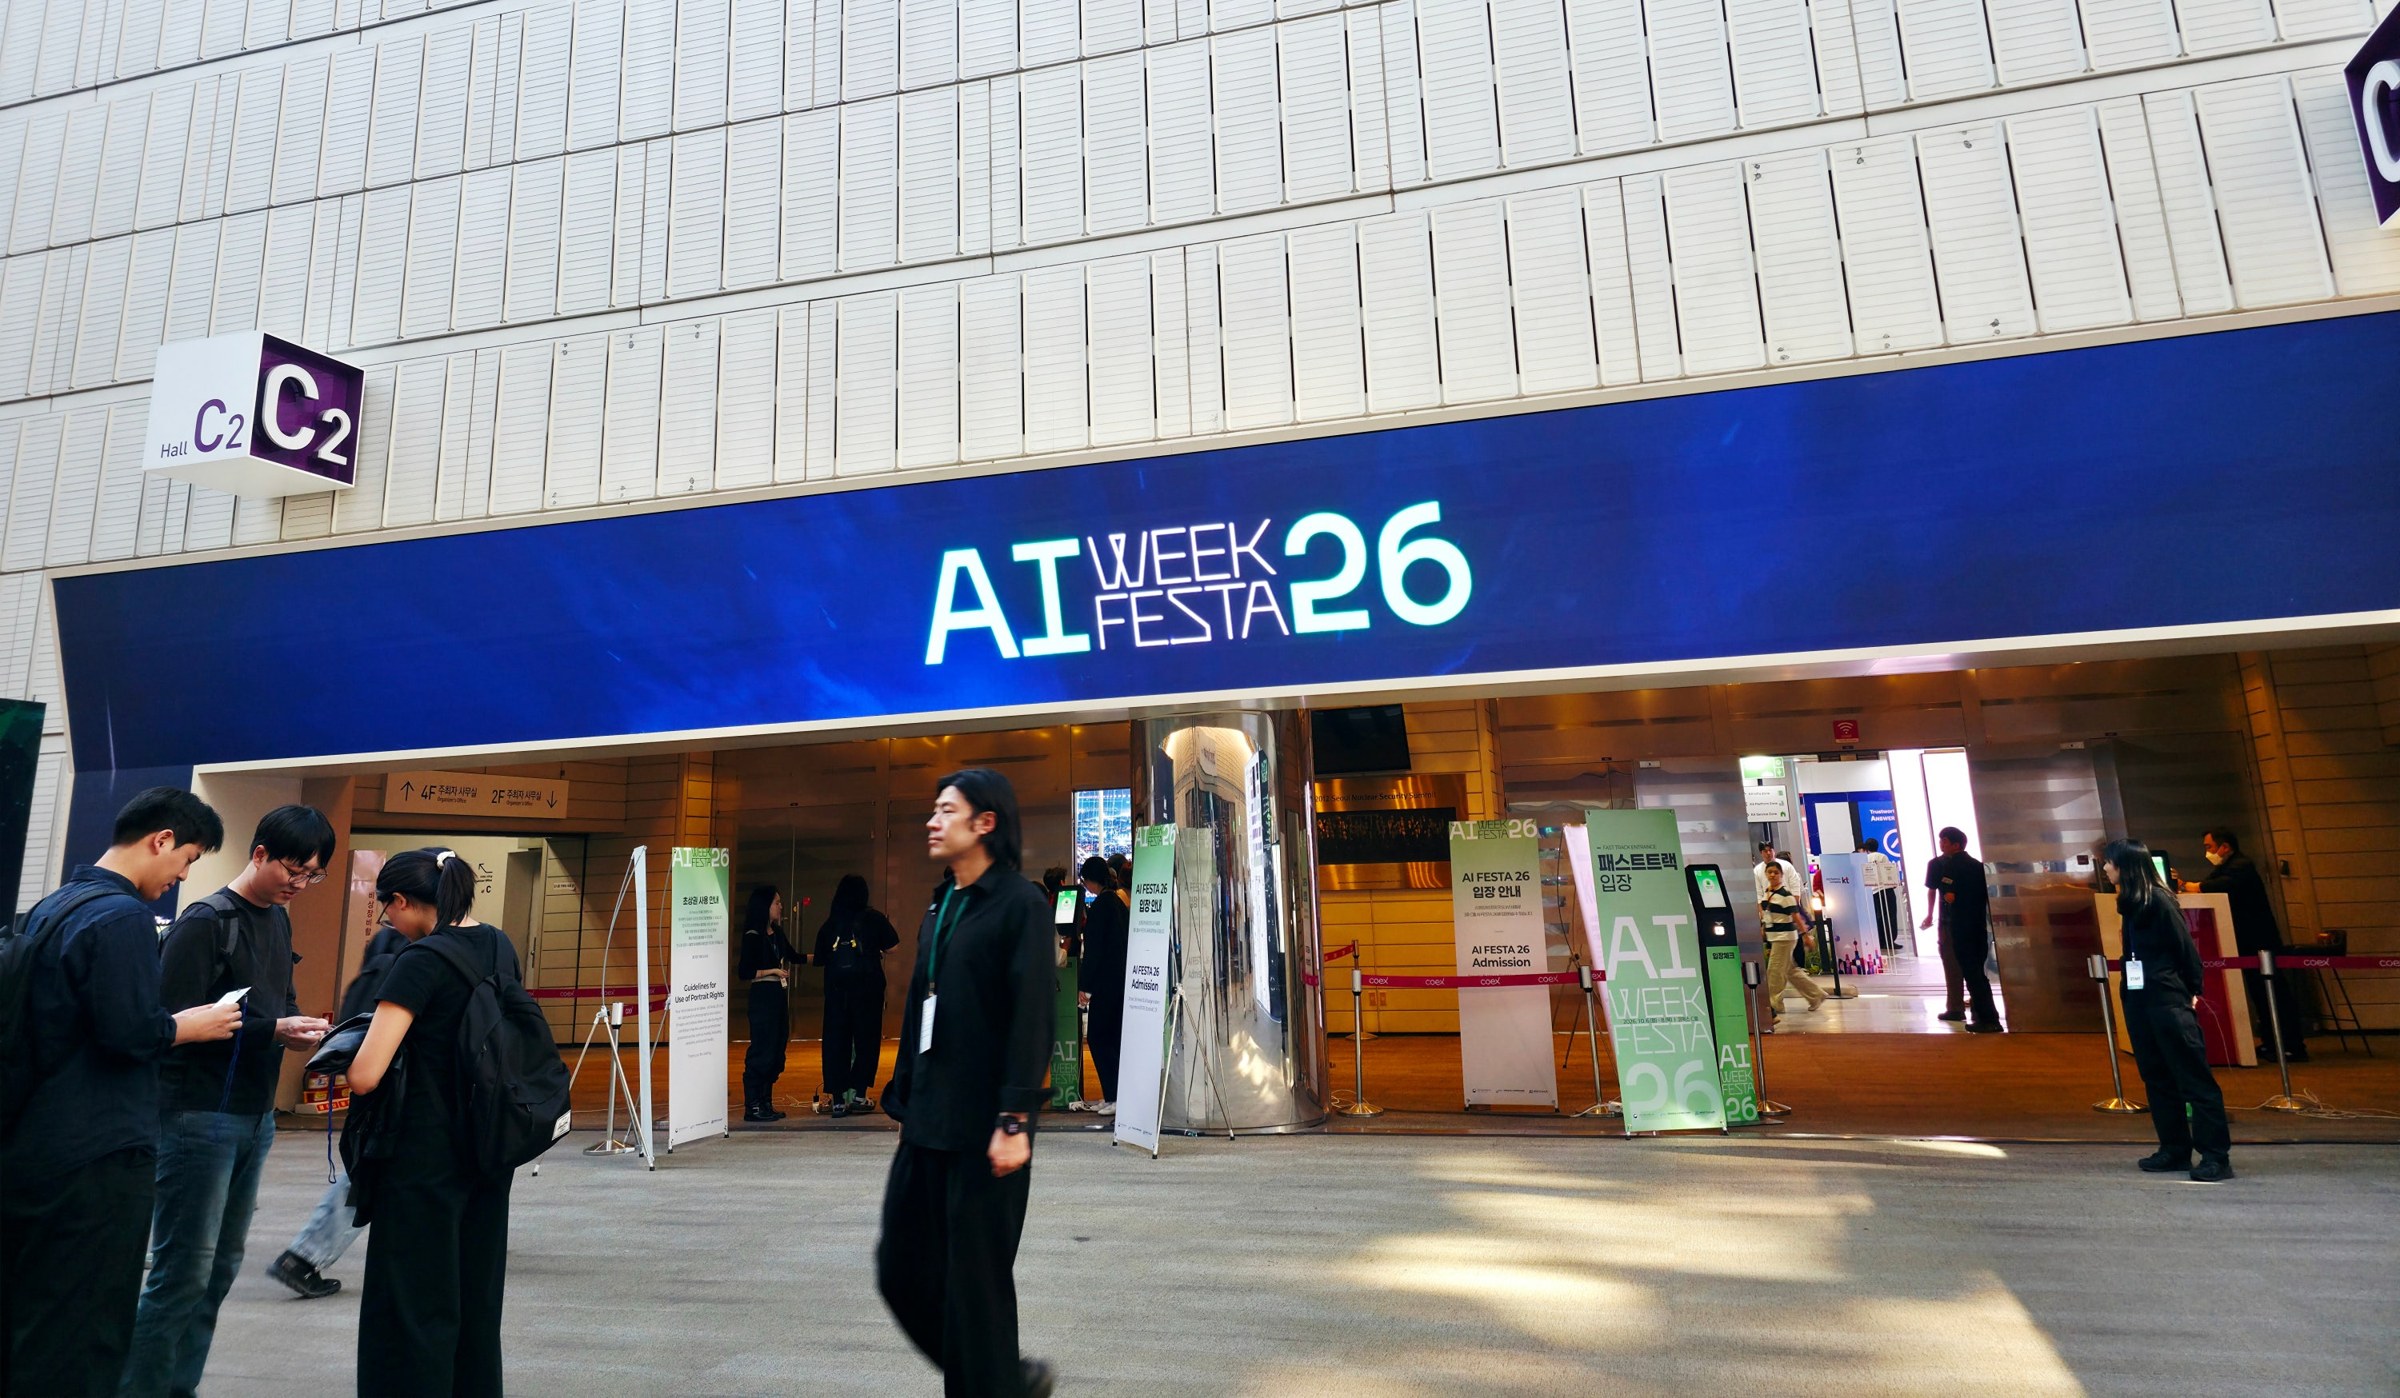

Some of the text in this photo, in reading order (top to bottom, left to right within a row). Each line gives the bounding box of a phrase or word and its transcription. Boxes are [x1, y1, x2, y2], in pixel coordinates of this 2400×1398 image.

[262, 364, 351, 466] C2
[160, 398, 245, 458] Hall C2
[1087, 518, 1277, 591] WEEK
[1284, 500, 1472, 634] 26
[925, 537, 1091, 665] AI
[1094, 580, 1290, 650] FESTA
[421, 785, 478, 800] 4F 주최자 사무실
[491, 789, 541, 804] 2F 주최자 사무실
[1352, 793, 1378, 801] Nuclear
[1379, 792, 1408, 801] Security
[1450, 821, 1478, 840] AI
[1477, 820, 1508, 830] WEEK
[1508, 818, 1538, 838] 26
[1135, 827, 1149, 847] AI
[1162, 823, 1176, 846] 26
[1477, 829, 1509, 840] FESTA
[672, 847, 691, 868] AI
[711, 848, 729, 868] 26
[1598, 853, 1678, 872] 패스트트랙
[1462, 871, 1530, 882] AI FESTA 26
[1600, 874, 1632, 892] 입장
[1841, 876, 1850, 884] kt
[1136, 883, 1168, 894] AI FESTA 26
[1473, 886, 1521, 899] 입장 안내
[683, 895, 719, 906] 초상권 사용 안내
[1139, 899, 1162, 913] 입장 안내
[1472, 945, 1530, 954] AI FESTA 26
[1607, 915, 1697, 980] AI
[1472, 957, 1531, 968] Admission
[2303, 957, 2331, 967] coex
[2379, 959, 2400, 967] coe
[1132, 965, 1160, 977] AI FESTA 26
[1131, 979, 1159, 992] Admission
[1368, 972, 1602, 986] coex coex coex coex ex
[684, 982, 709, 992] Guidelines
[675, 990, 725, 1004] Use of Portrait Rights
[1609, 985, 1705, 1020] WEEK
[1613, 1021, 1715, 1055] FESTA
[1719, 1044, 1751, 1069] AI
[1722, 1069, 1753, 1083] WEEK
[1625, 1059, 1719, 1128] 26
[1722, 1082, 1755, 1095] FESTA
[1726, 1096, 1758, 1122] 26
